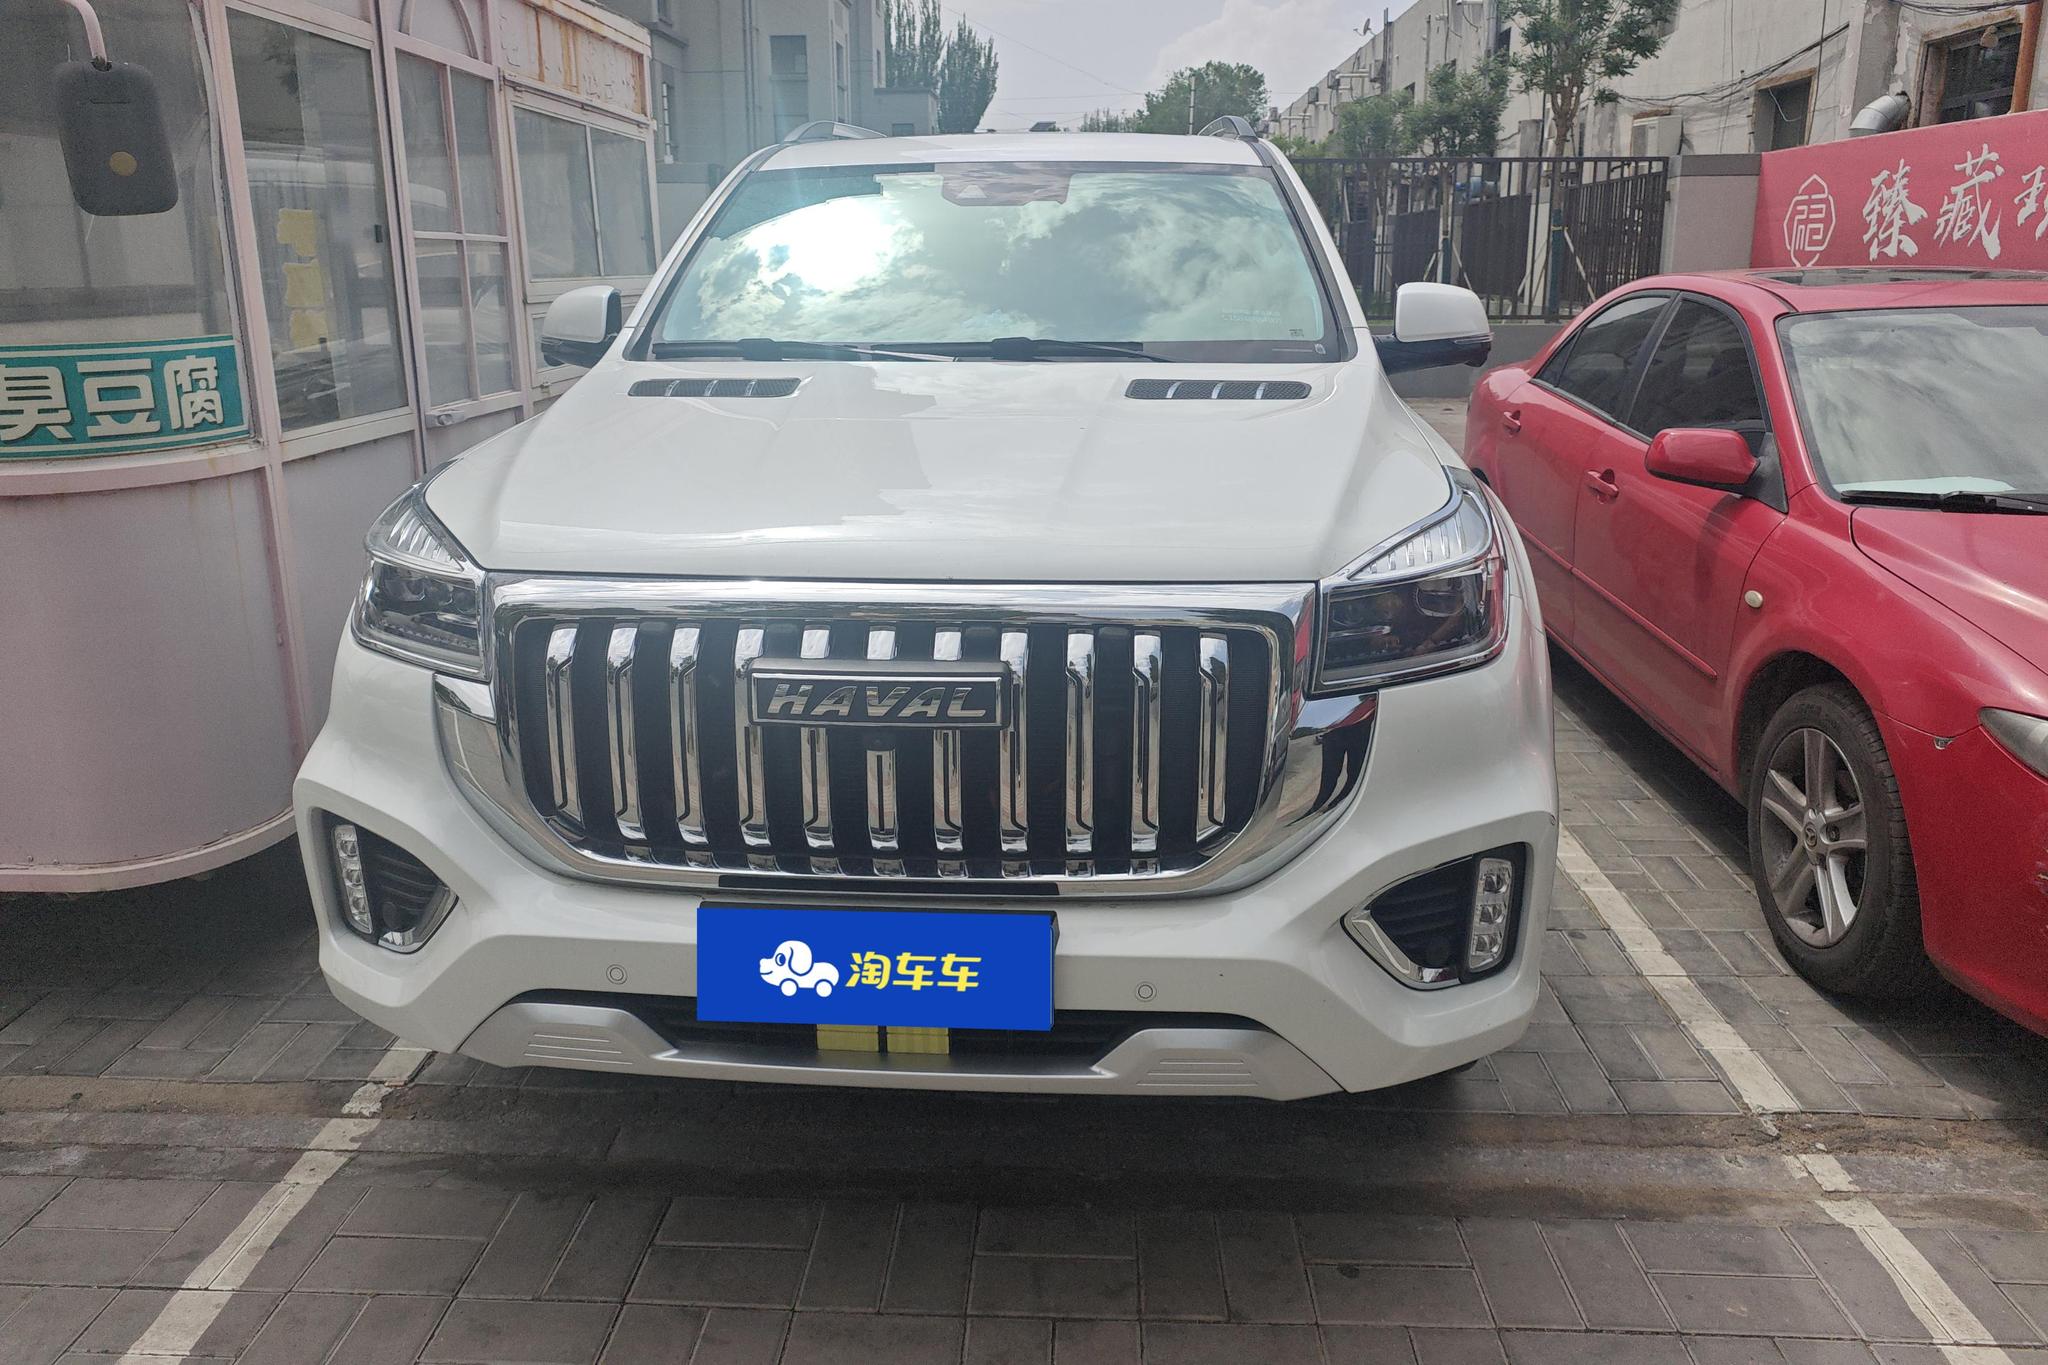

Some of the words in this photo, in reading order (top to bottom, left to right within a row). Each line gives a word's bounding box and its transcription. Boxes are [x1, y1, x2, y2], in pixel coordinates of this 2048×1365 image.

[0, 353, 224, 440] 臭豆腐
[767, 683, 987, 718] HAVAL
